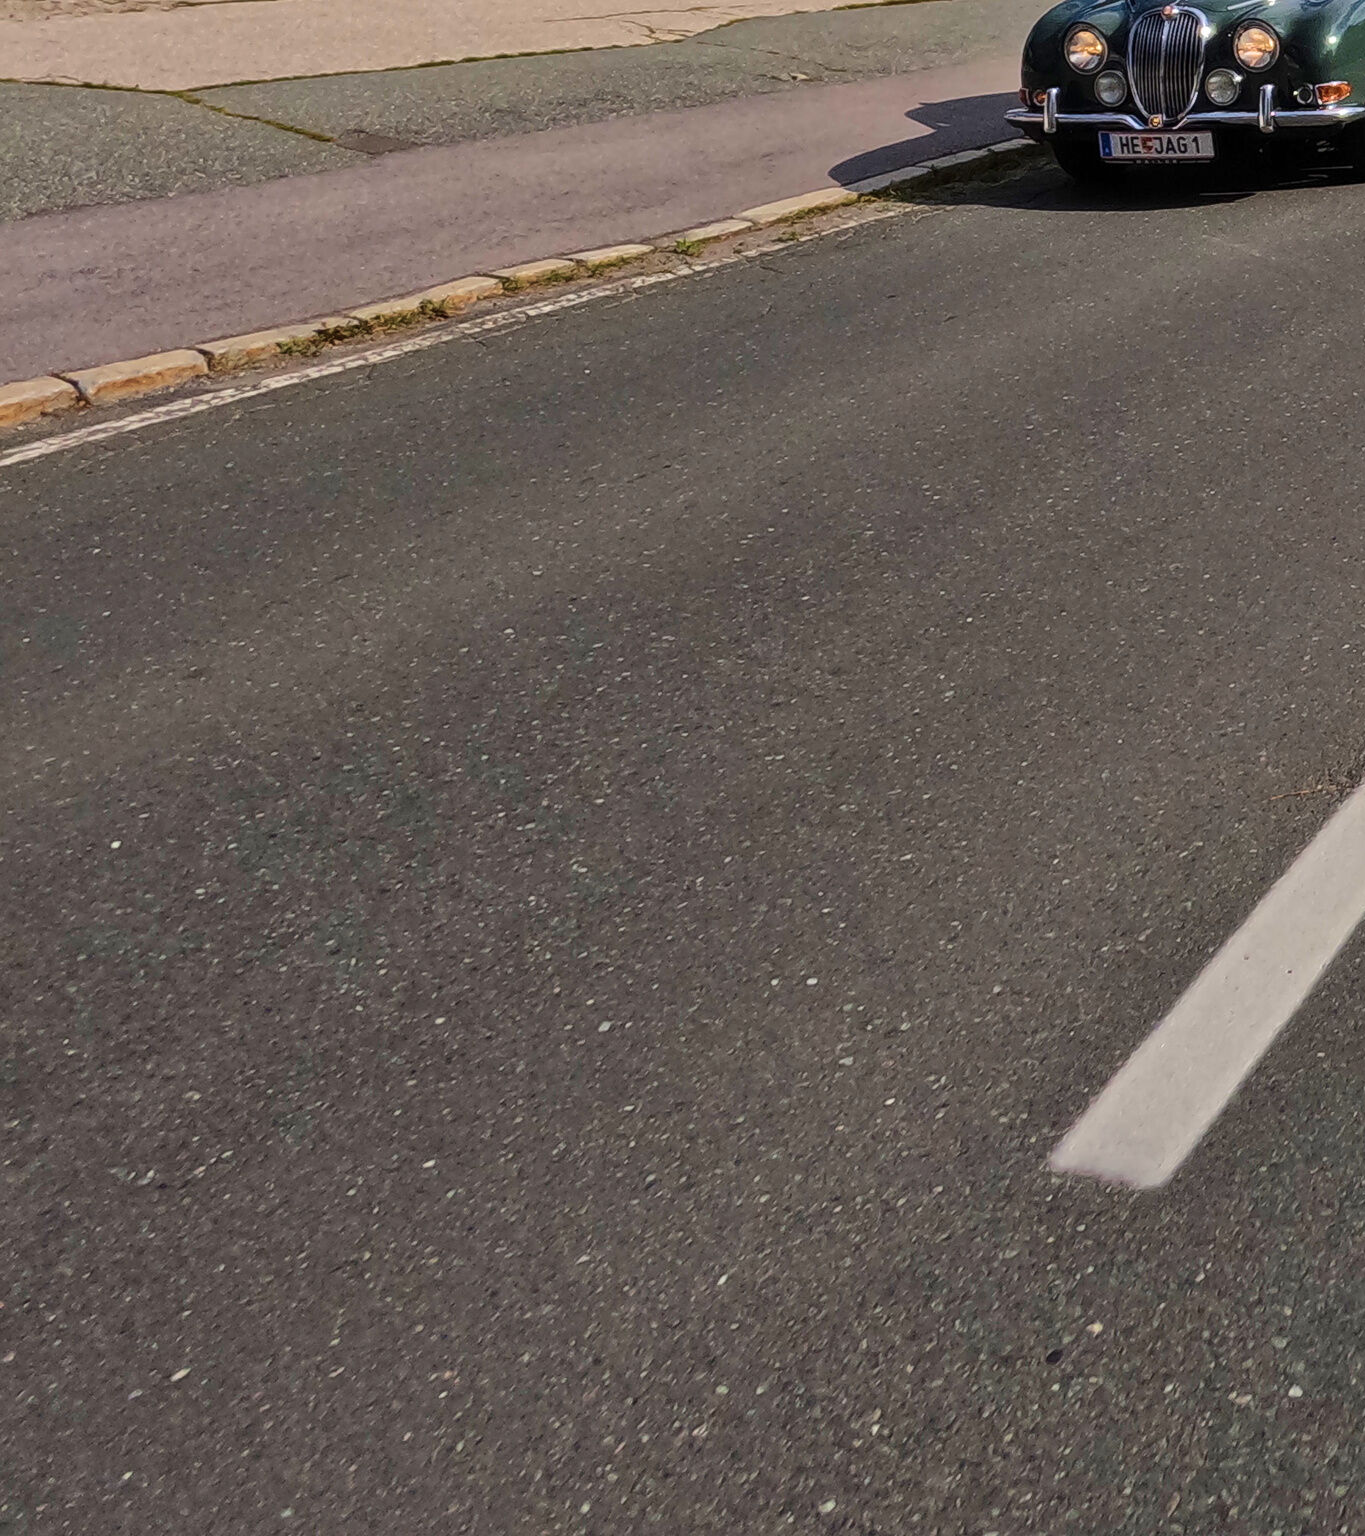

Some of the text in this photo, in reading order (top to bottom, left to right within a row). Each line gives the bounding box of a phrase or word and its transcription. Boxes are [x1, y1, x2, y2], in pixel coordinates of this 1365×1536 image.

[1119, 136, 1201, 154] HE JAG 1
